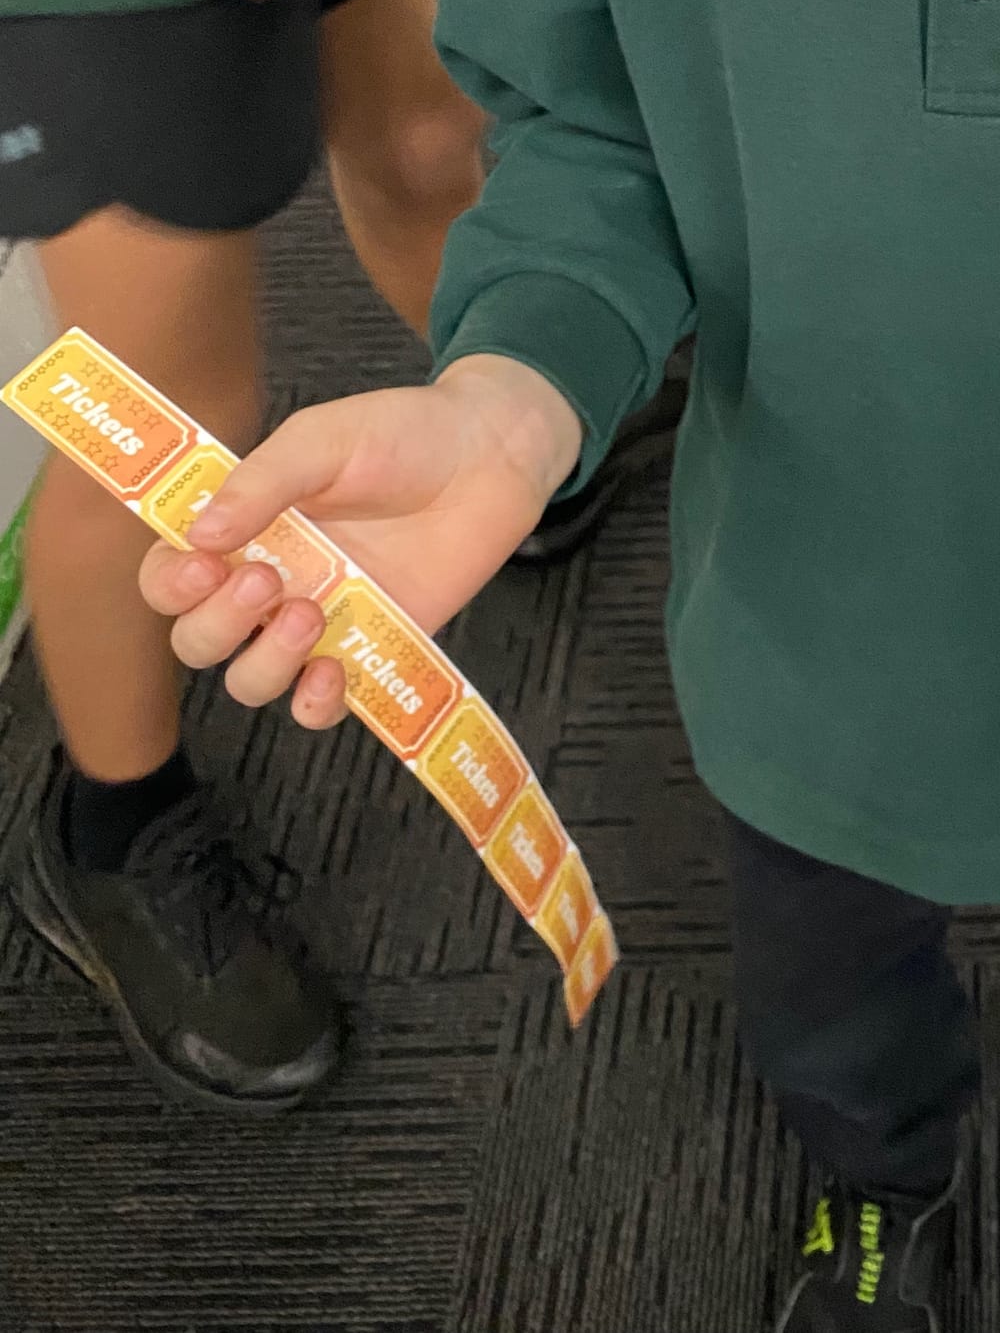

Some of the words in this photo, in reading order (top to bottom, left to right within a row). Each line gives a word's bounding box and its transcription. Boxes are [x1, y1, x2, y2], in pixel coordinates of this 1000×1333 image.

[48, 372, 145, 456] Tickets
[337, 626, 423, 715] Tickets
[450, 740, 500, 809] Tickets
